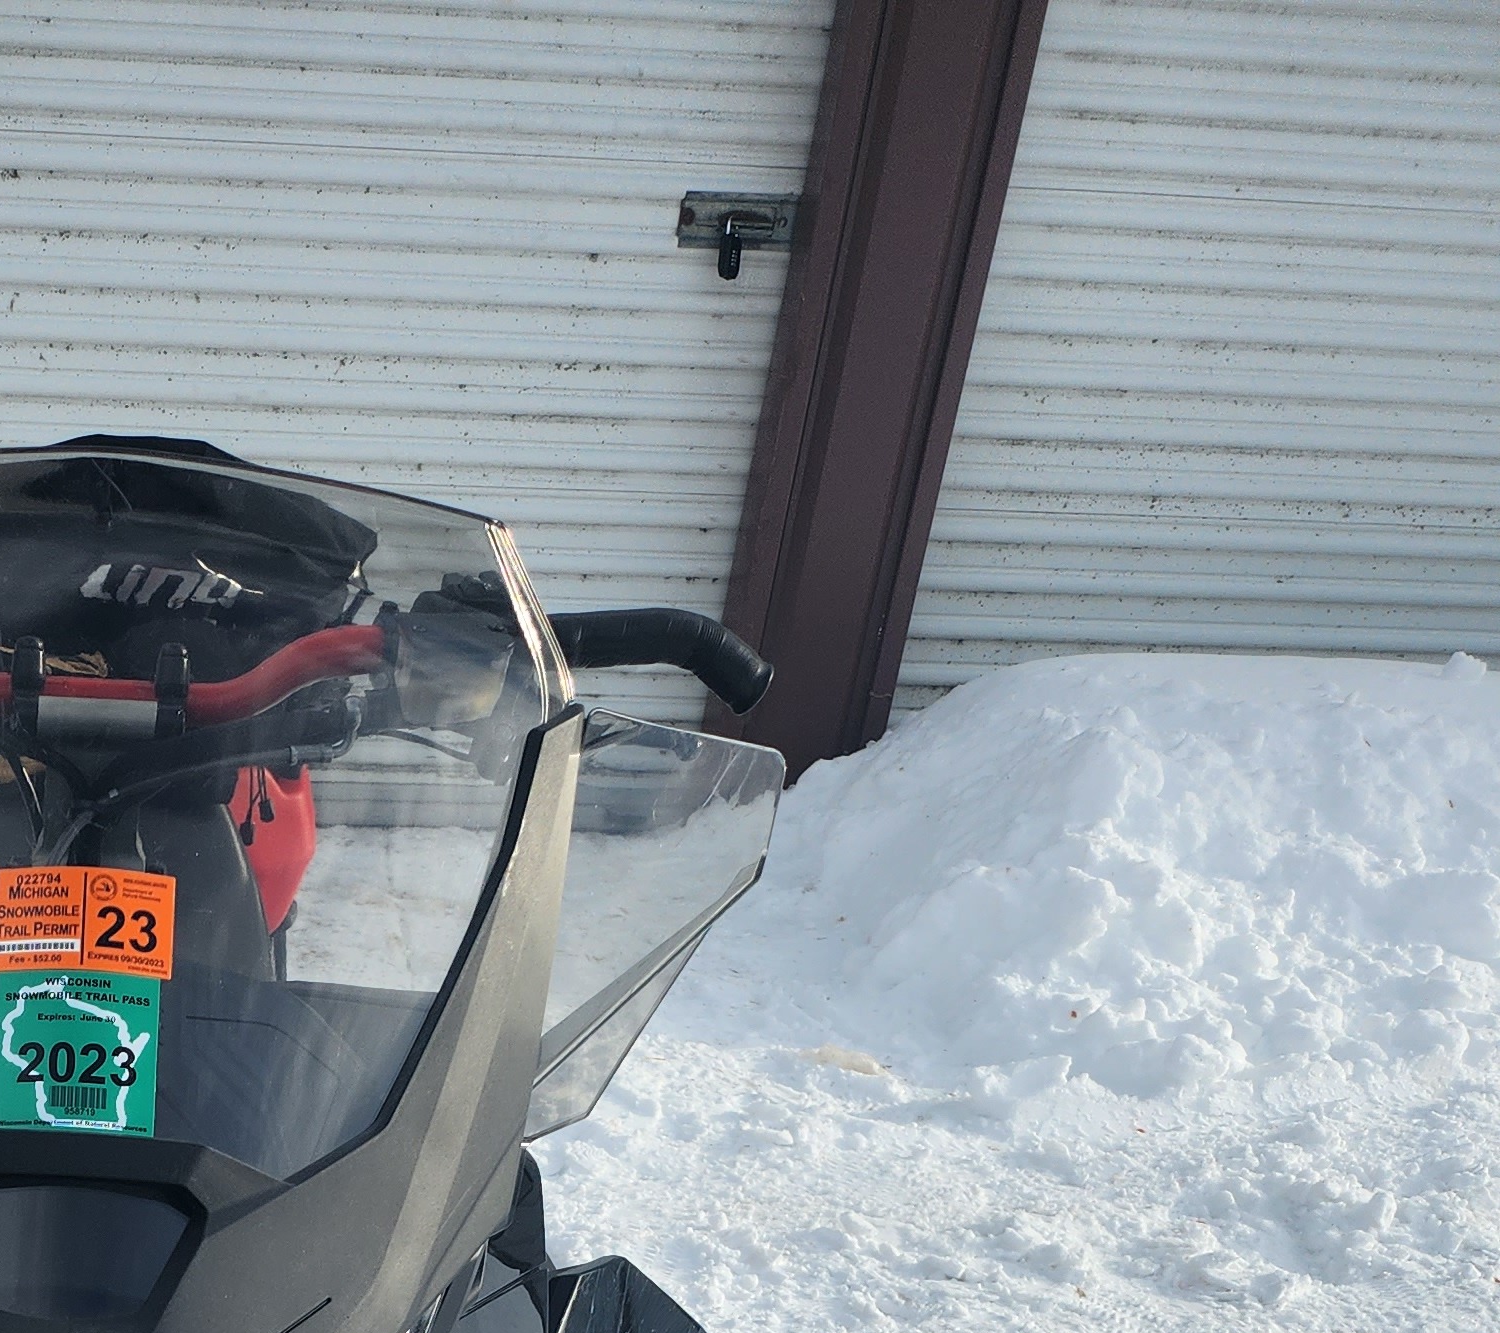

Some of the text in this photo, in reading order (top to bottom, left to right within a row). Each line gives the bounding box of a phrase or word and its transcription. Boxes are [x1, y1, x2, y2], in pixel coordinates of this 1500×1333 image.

[16, 873, 61, 886] 022794
[8, 886, 69, 900] MICHIGAN
[34, 922, 80, 936] PERMIT
[95, 905, 157, 953] 23
[9, 955, 25, 964] Fee
[87, 951, 119, 962] EXPIRES
[45, 977, 111, 988] WISCONSIN
[5, 991, 150, 1007] SNOWMOBILE TRAIL PASS
[37, 1013, 116, 1023] Expires: June 30
[16, 1042, 137, 1087] 2023
[64, 1107, 95, 1117] 958719
